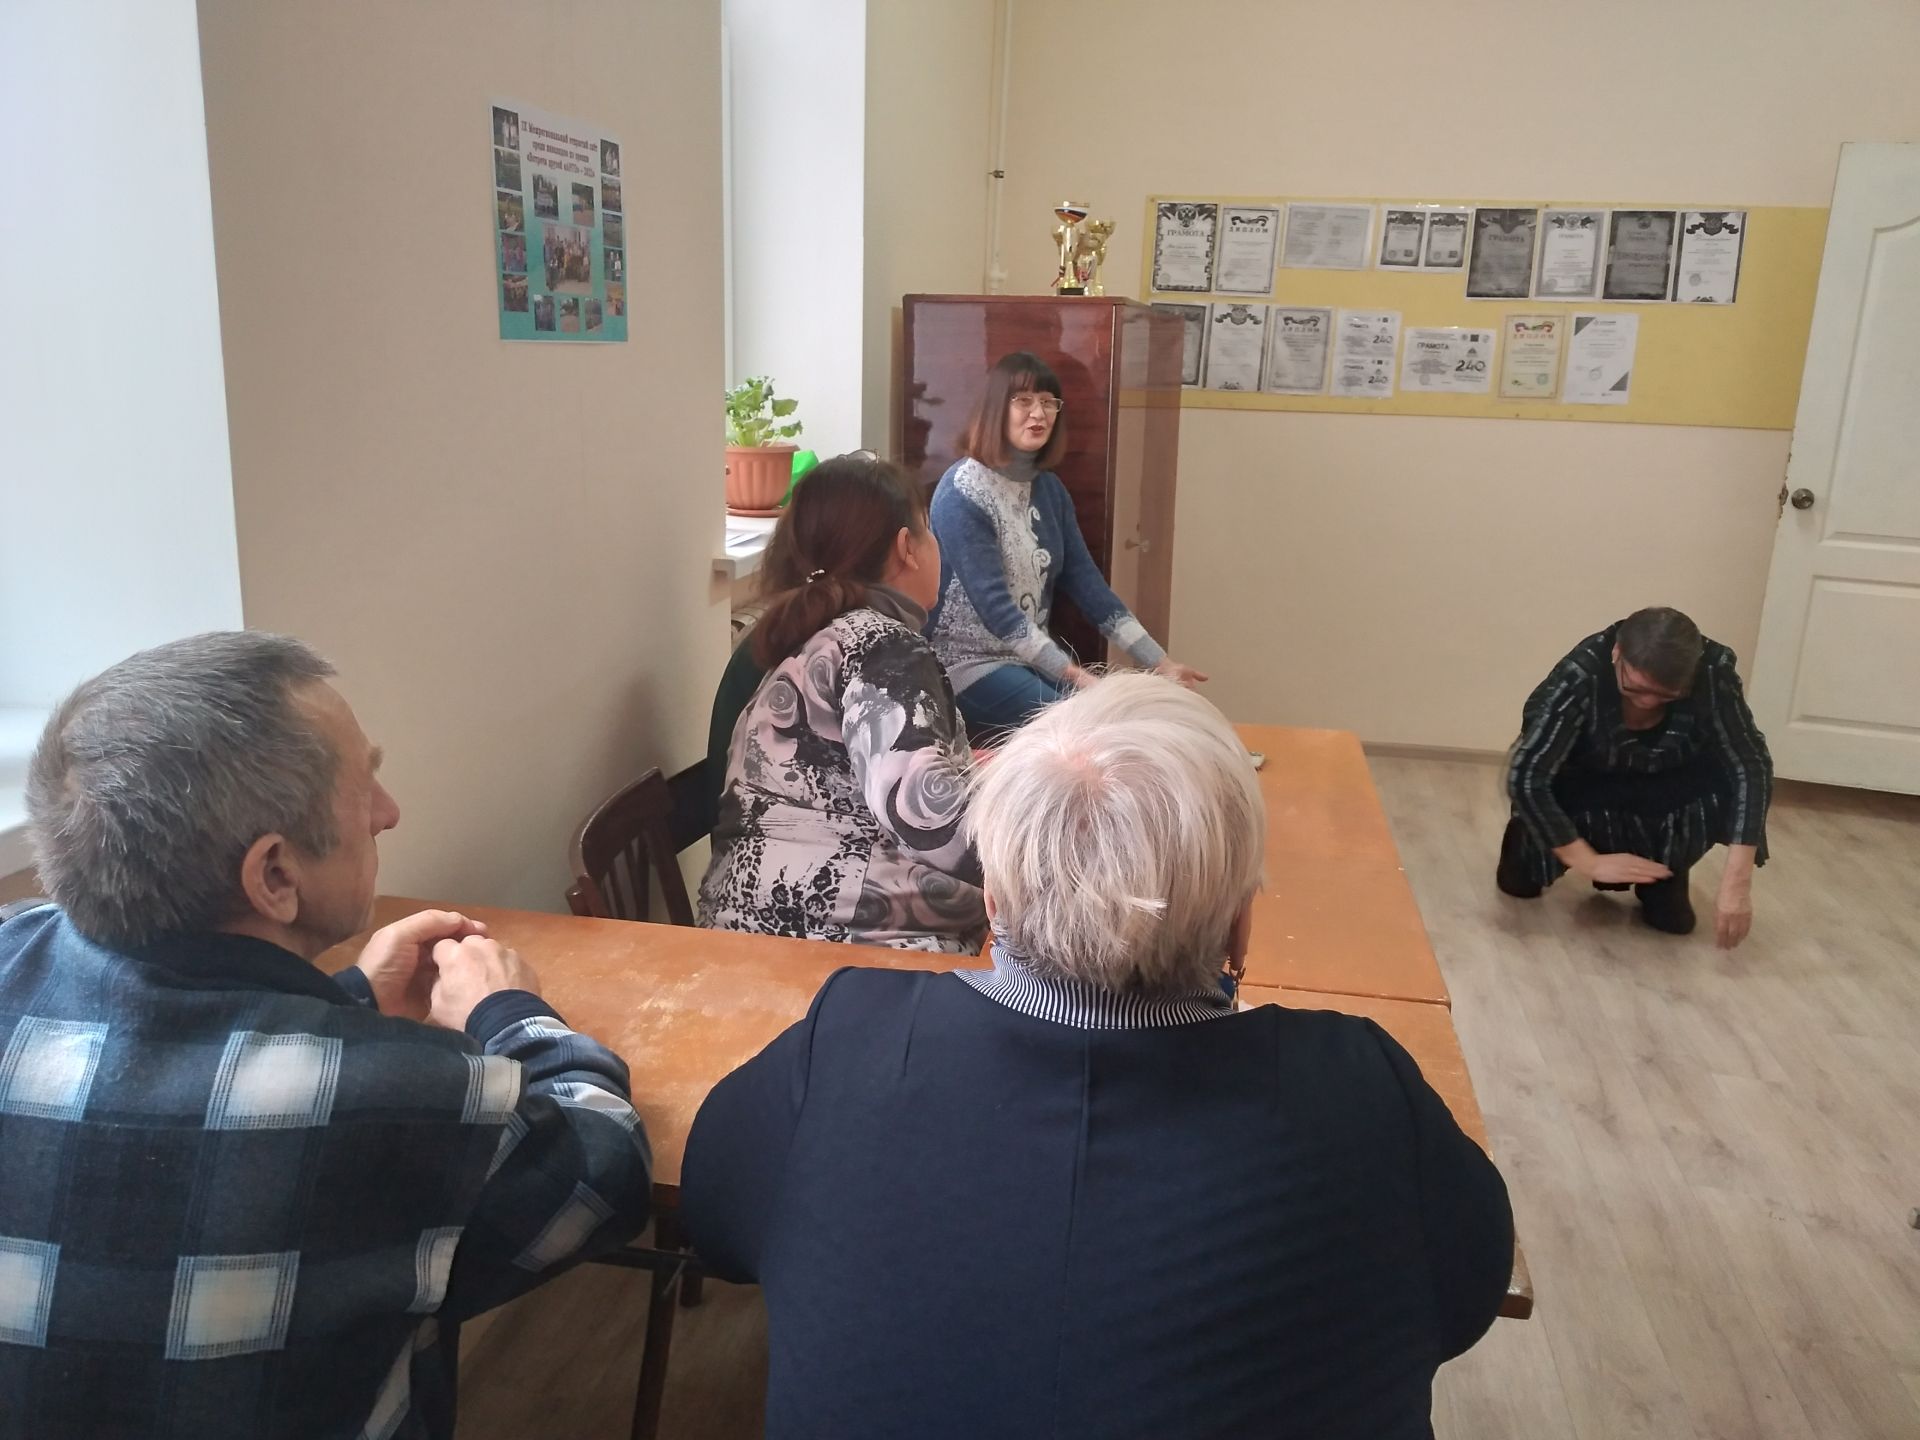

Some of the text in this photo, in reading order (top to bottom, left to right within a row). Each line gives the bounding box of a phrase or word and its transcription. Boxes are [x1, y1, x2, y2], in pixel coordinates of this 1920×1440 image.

[1167, 229, 1205, 237] ГРАМОТА
[1417, 342, 1450, 350] ГРАМОТА
[1456, 359, 1486, 372] 240
